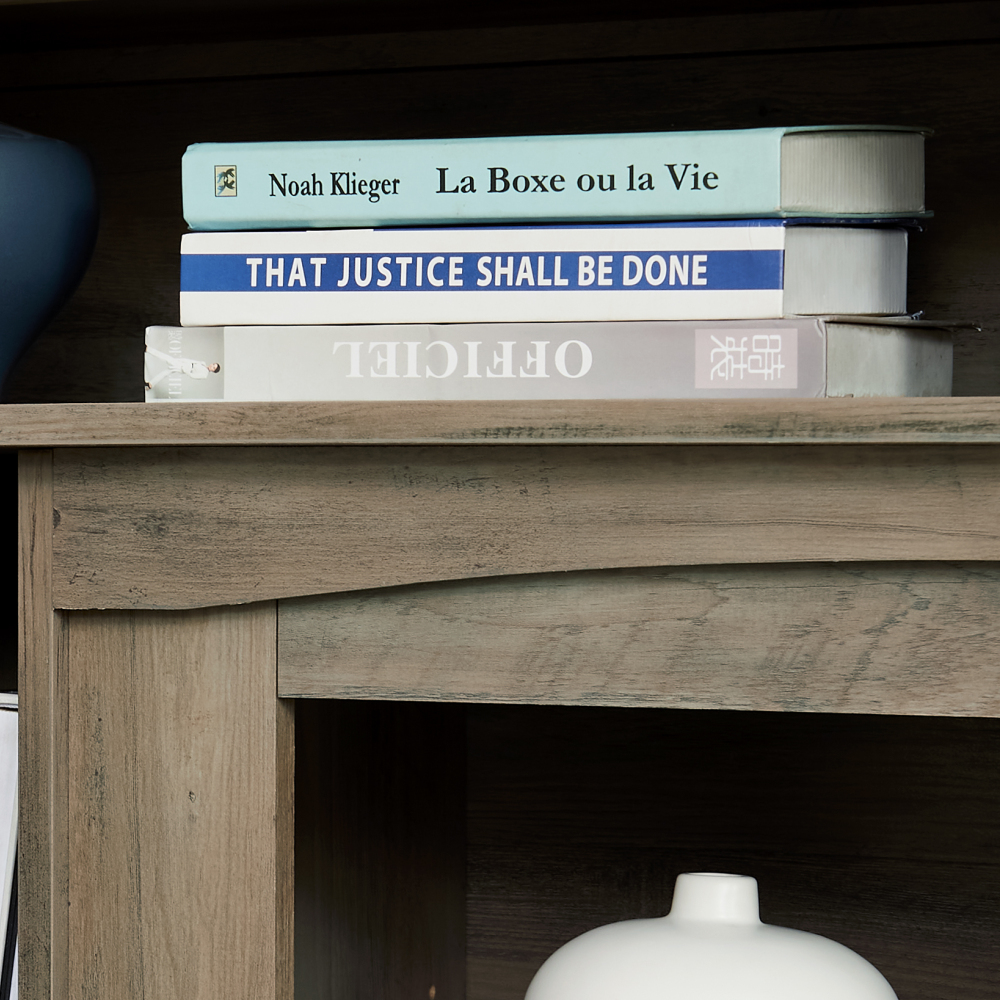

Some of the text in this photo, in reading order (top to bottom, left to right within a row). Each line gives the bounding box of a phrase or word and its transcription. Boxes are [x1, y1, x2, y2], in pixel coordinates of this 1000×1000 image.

[268, 171, 401, 203] Noah Klieger
[435, 163, 719, 194] La Boxe ou la Vie
[246, 254, 708, 288] THAT JUSTICE SHALL BE DONE
[332, 340, 593, 378] OFFICIEL
